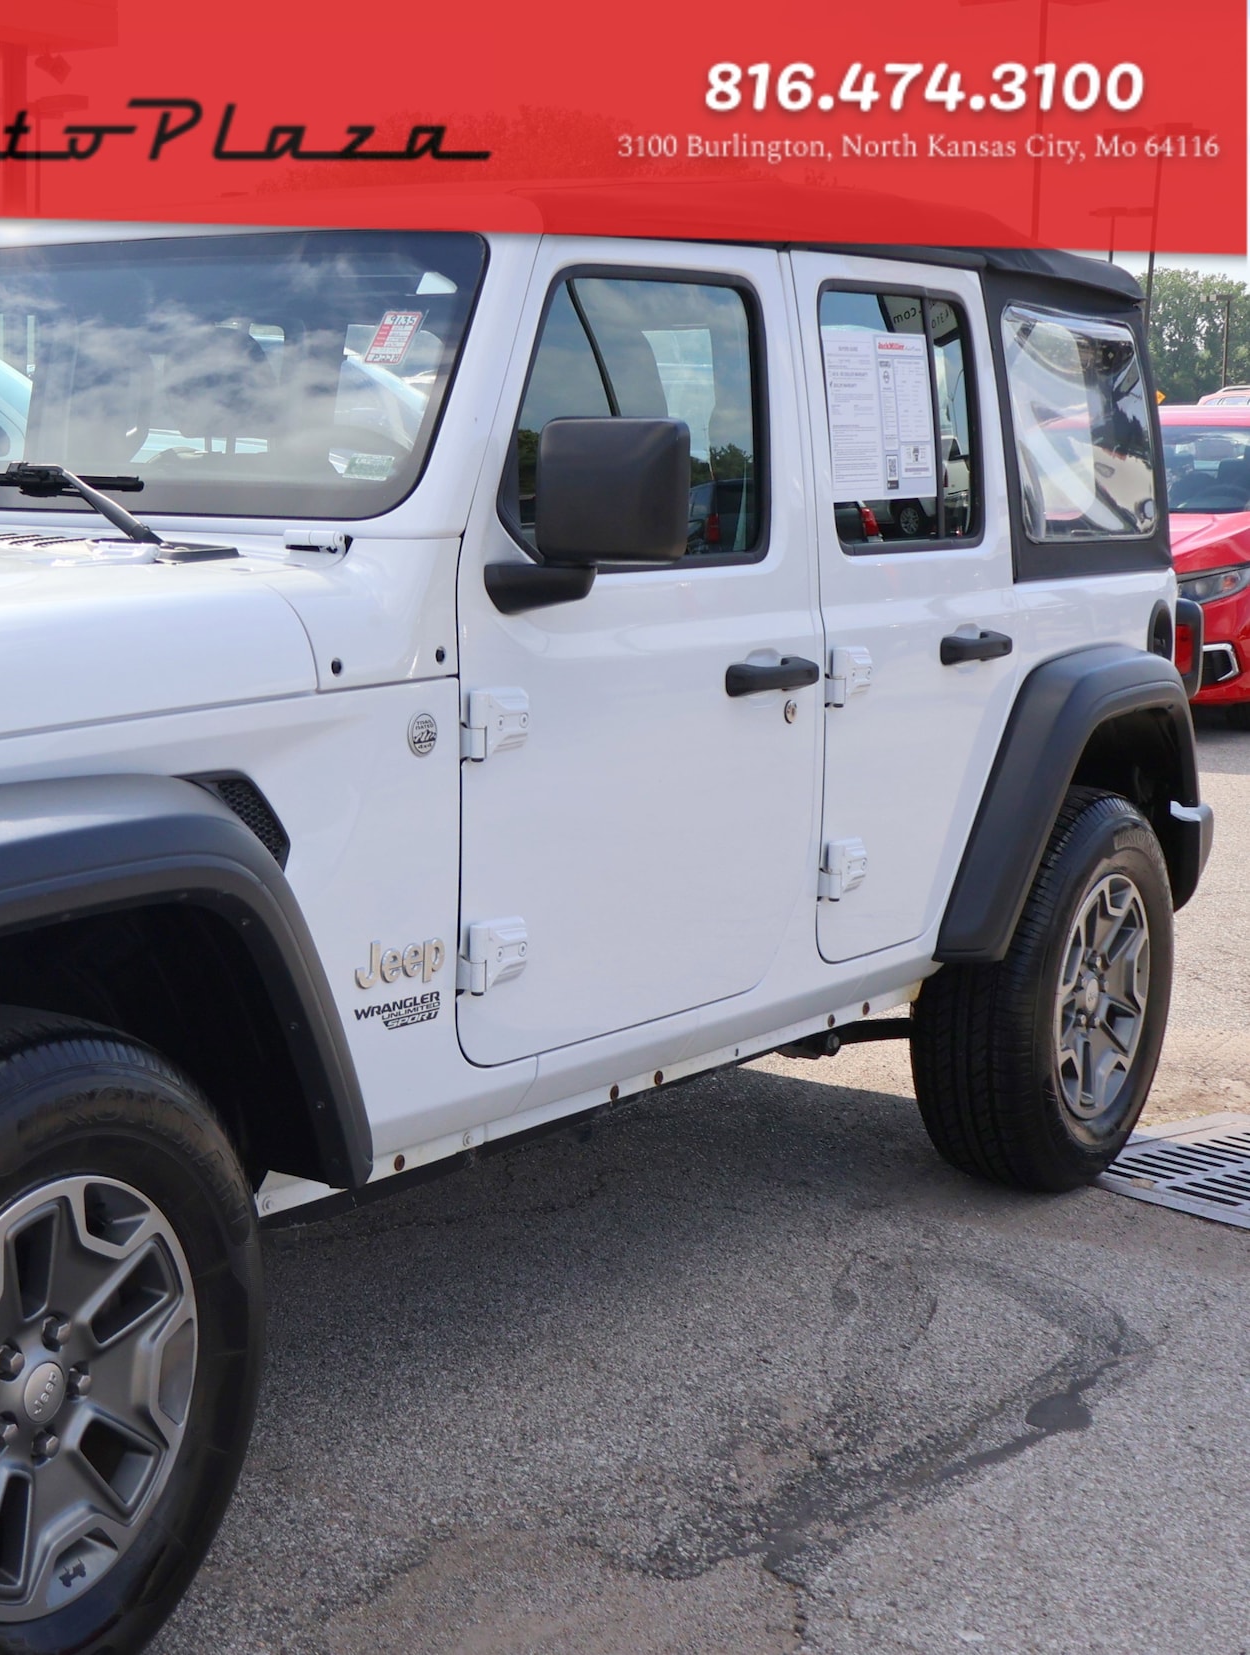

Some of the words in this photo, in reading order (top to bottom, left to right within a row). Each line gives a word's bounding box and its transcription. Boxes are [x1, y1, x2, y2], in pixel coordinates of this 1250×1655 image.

[355, 937, 445, 990] Jeep
[354, 991, 441, 1021] WRANGLER
[381, 1002, 441, 1020] UNLIMITED
[386, 1010, 439, 1029] SPORT
[33, 1371, 57, 1415] Jeep
